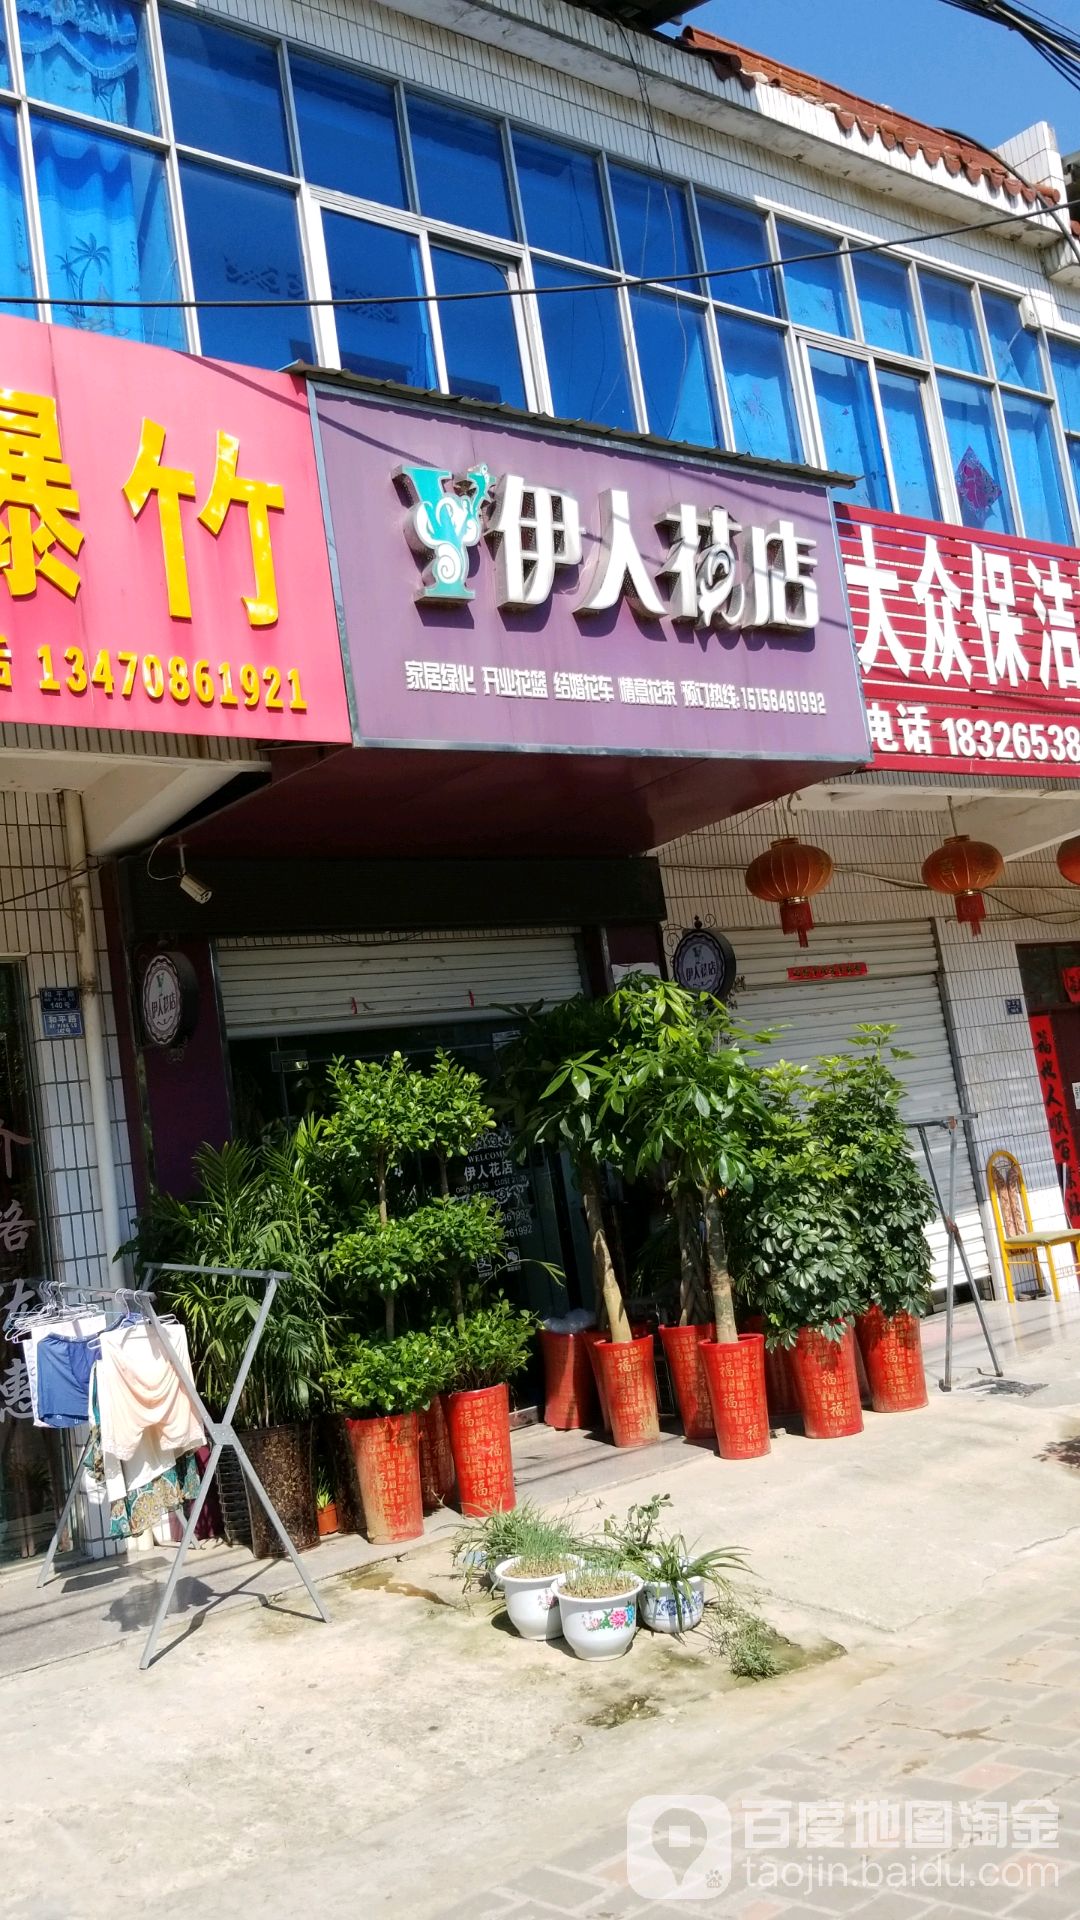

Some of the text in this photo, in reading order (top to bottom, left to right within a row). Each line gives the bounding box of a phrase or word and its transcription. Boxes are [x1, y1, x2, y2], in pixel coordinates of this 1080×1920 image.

[487, 474, 821, 633] 伊人花店
[845, 525, 1080, 691] 大众保洁
[37, 643, 307, 710] 13470861921
[404, 660, 477, 695] 家居绿化
[481, 666, 549, 699] 开业花篮
[553, 671, 615, 703] 结婚花车
[617, 676, 678, 706] 情意花束
[868, 703, 933, 754] 电话
[150, 991, 177, 1020] 伊人花店
[464, 1160, 513, 1182] 伊人花店
